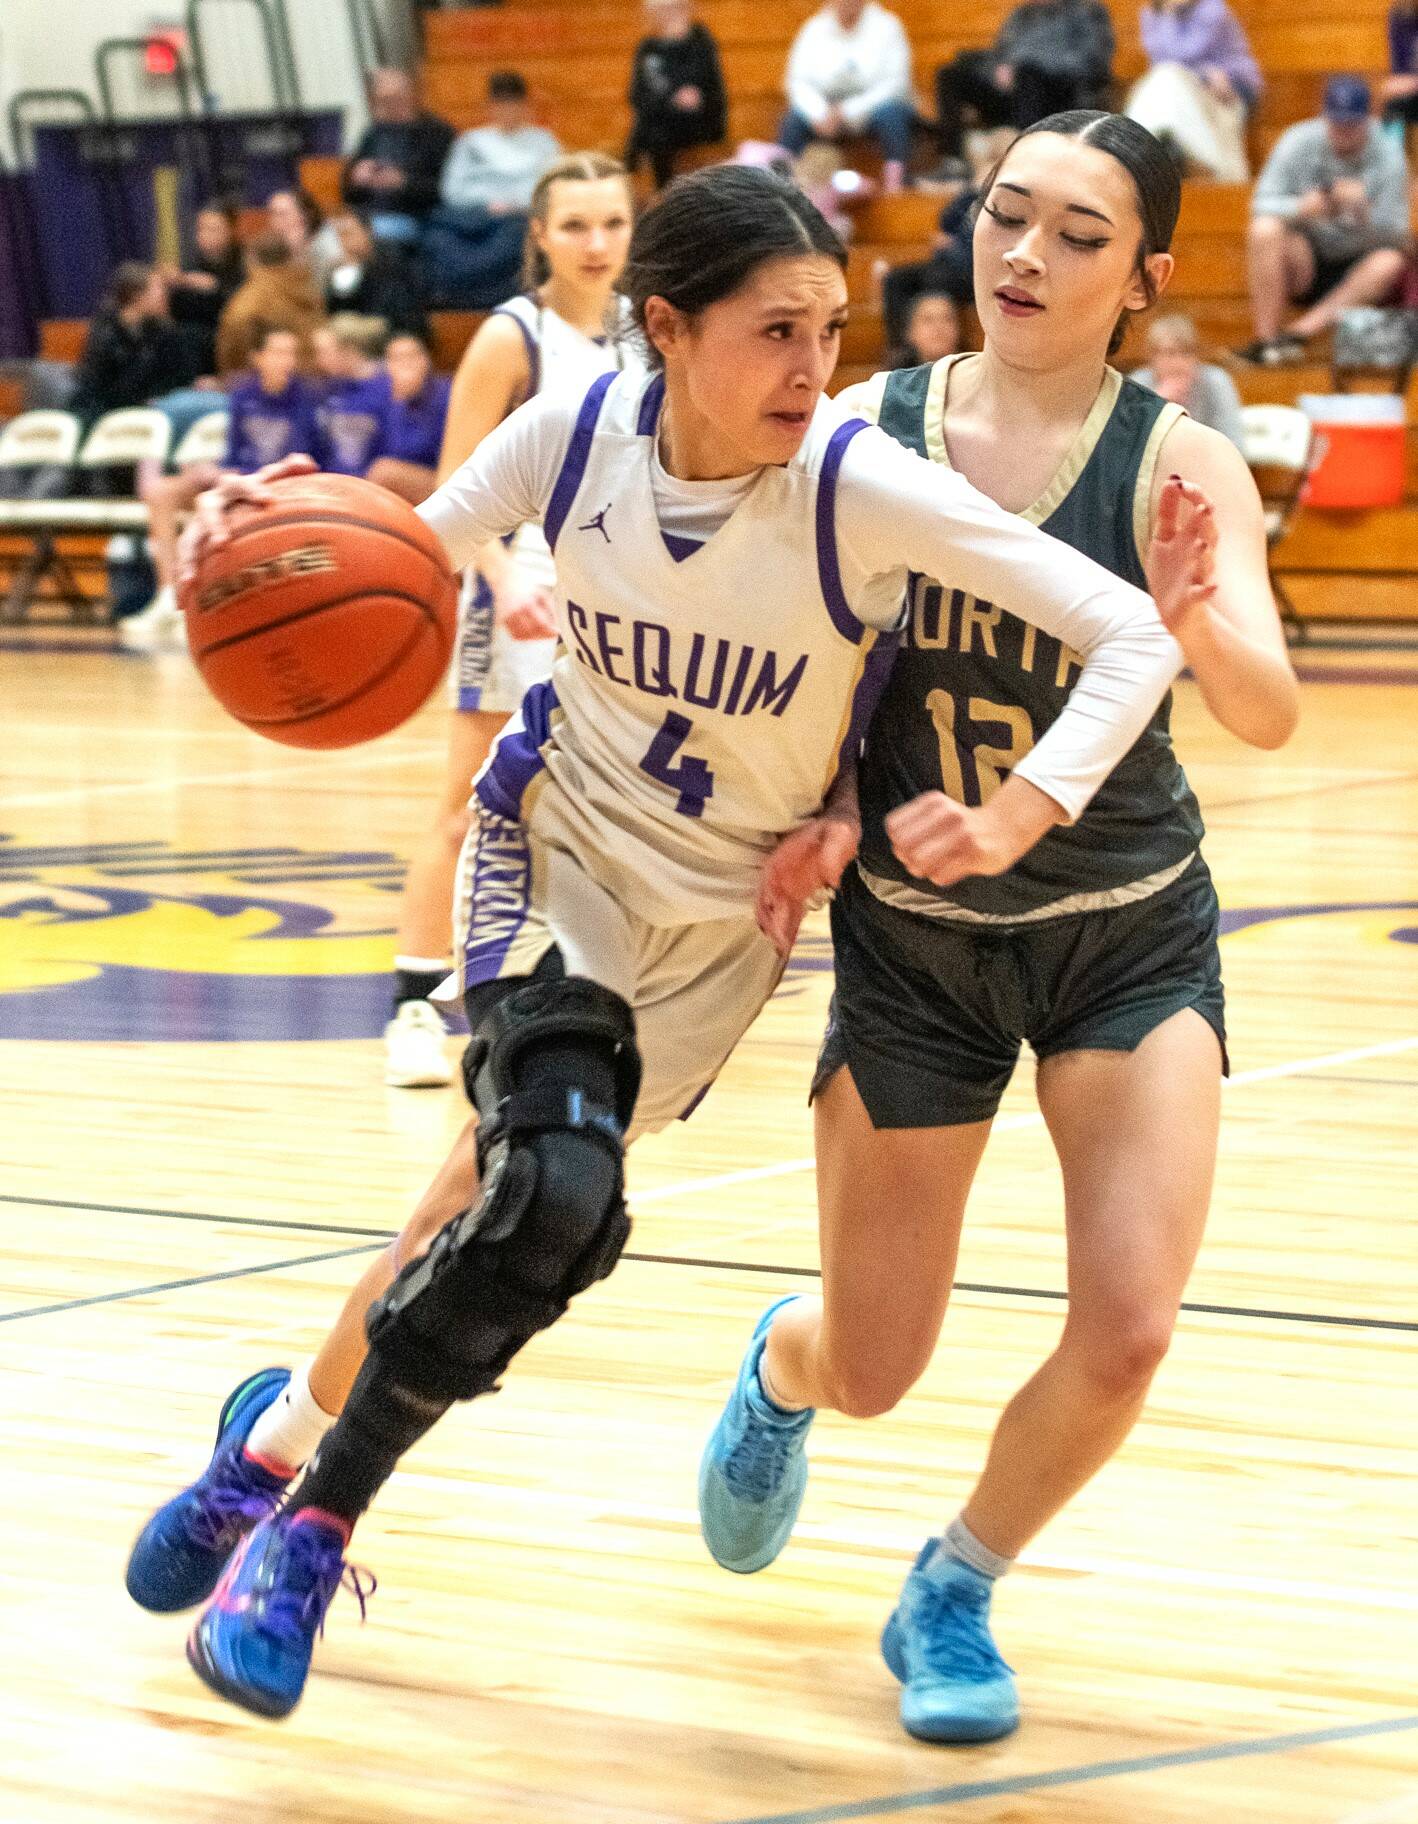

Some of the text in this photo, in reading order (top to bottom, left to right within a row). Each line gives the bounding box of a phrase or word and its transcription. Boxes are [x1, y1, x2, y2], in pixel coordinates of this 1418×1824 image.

[567, 599, 809, 717] SEQUIM
[639, 709, 714, 818] 4
[925, 688, 1034, 807] 12
